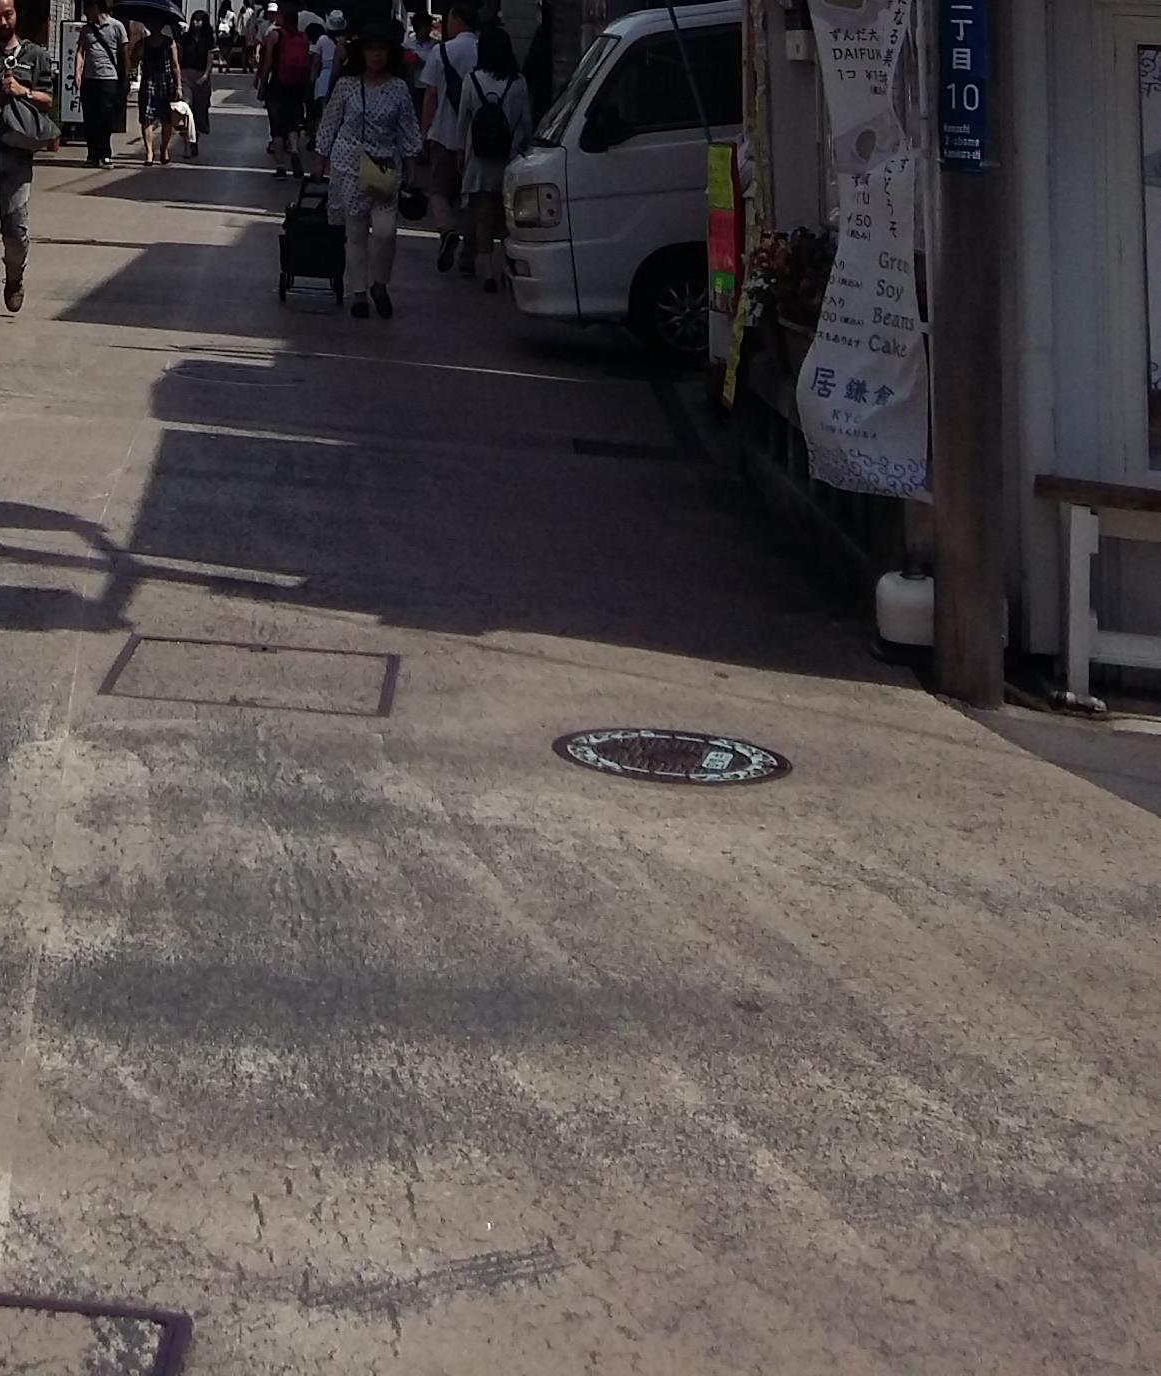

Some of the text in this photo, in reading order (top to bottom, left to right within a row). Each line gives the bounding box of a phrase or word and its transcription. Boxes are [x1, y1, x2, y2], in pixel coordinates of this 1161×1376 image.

[946, 83, 980, 112] 10
[875, 279, 904, 303] Soy
[871, 306, 916, 331] Beans
[868, 334, 908, 359] Cake
